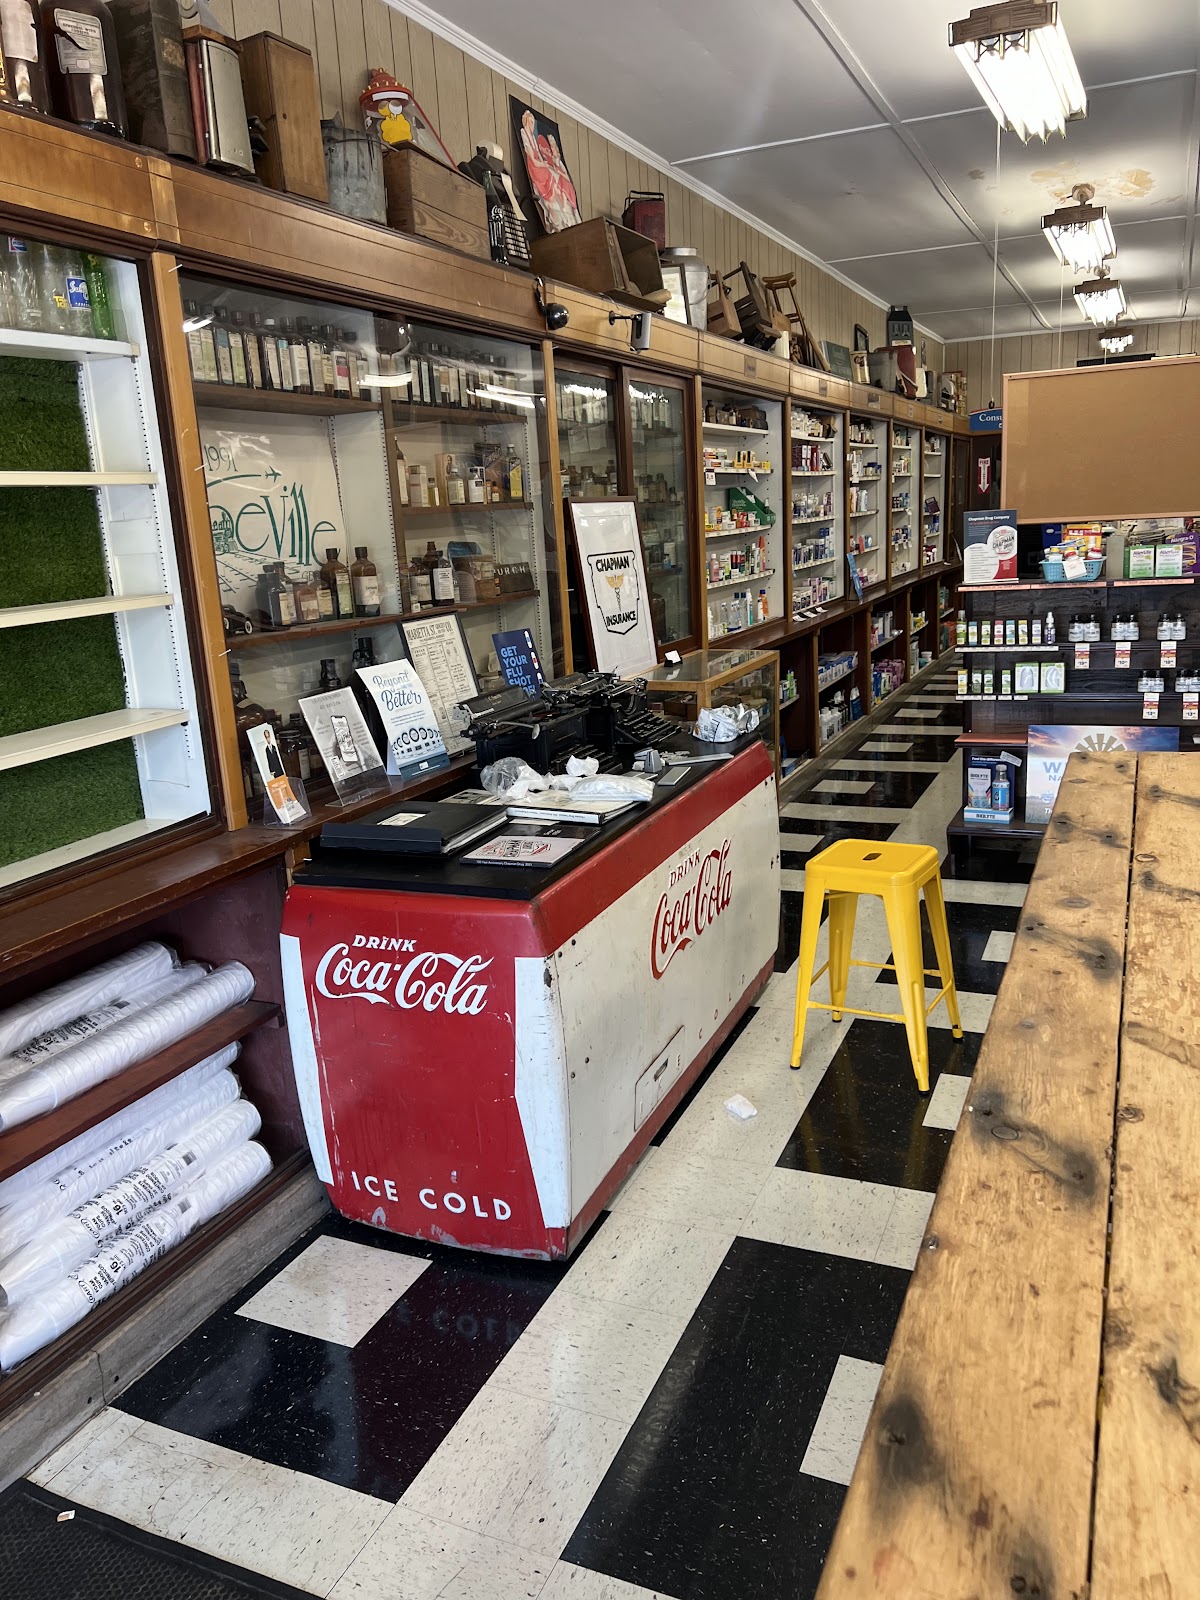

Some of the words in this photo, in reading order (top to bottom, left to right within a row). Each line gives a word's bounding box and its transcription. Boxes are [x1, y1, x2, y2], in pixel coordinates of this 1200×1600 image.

[204, 444, 238, 472] 1991
[595, 555, 630, 573] CHAPMAN
[605, 610, 636, 627] INSURANCE
[500, 645, 517, 658] GET
[503, 654, 529, 668] YOUR
[372, 670, 409, 693] Beyond
[506, 666, 524, 679] FLU
[381, 690, 422, 711] Better
[669, 848, 701, 889] DRINK
[352, 934, 418, 953] DRINK
[315, 942, 495, 1015] Coca-Cola
[351, 1171, 399, 1202] ICE
[418, 1188, 512, 1221] COLD
[110, 1261, 121, 1274] 16
